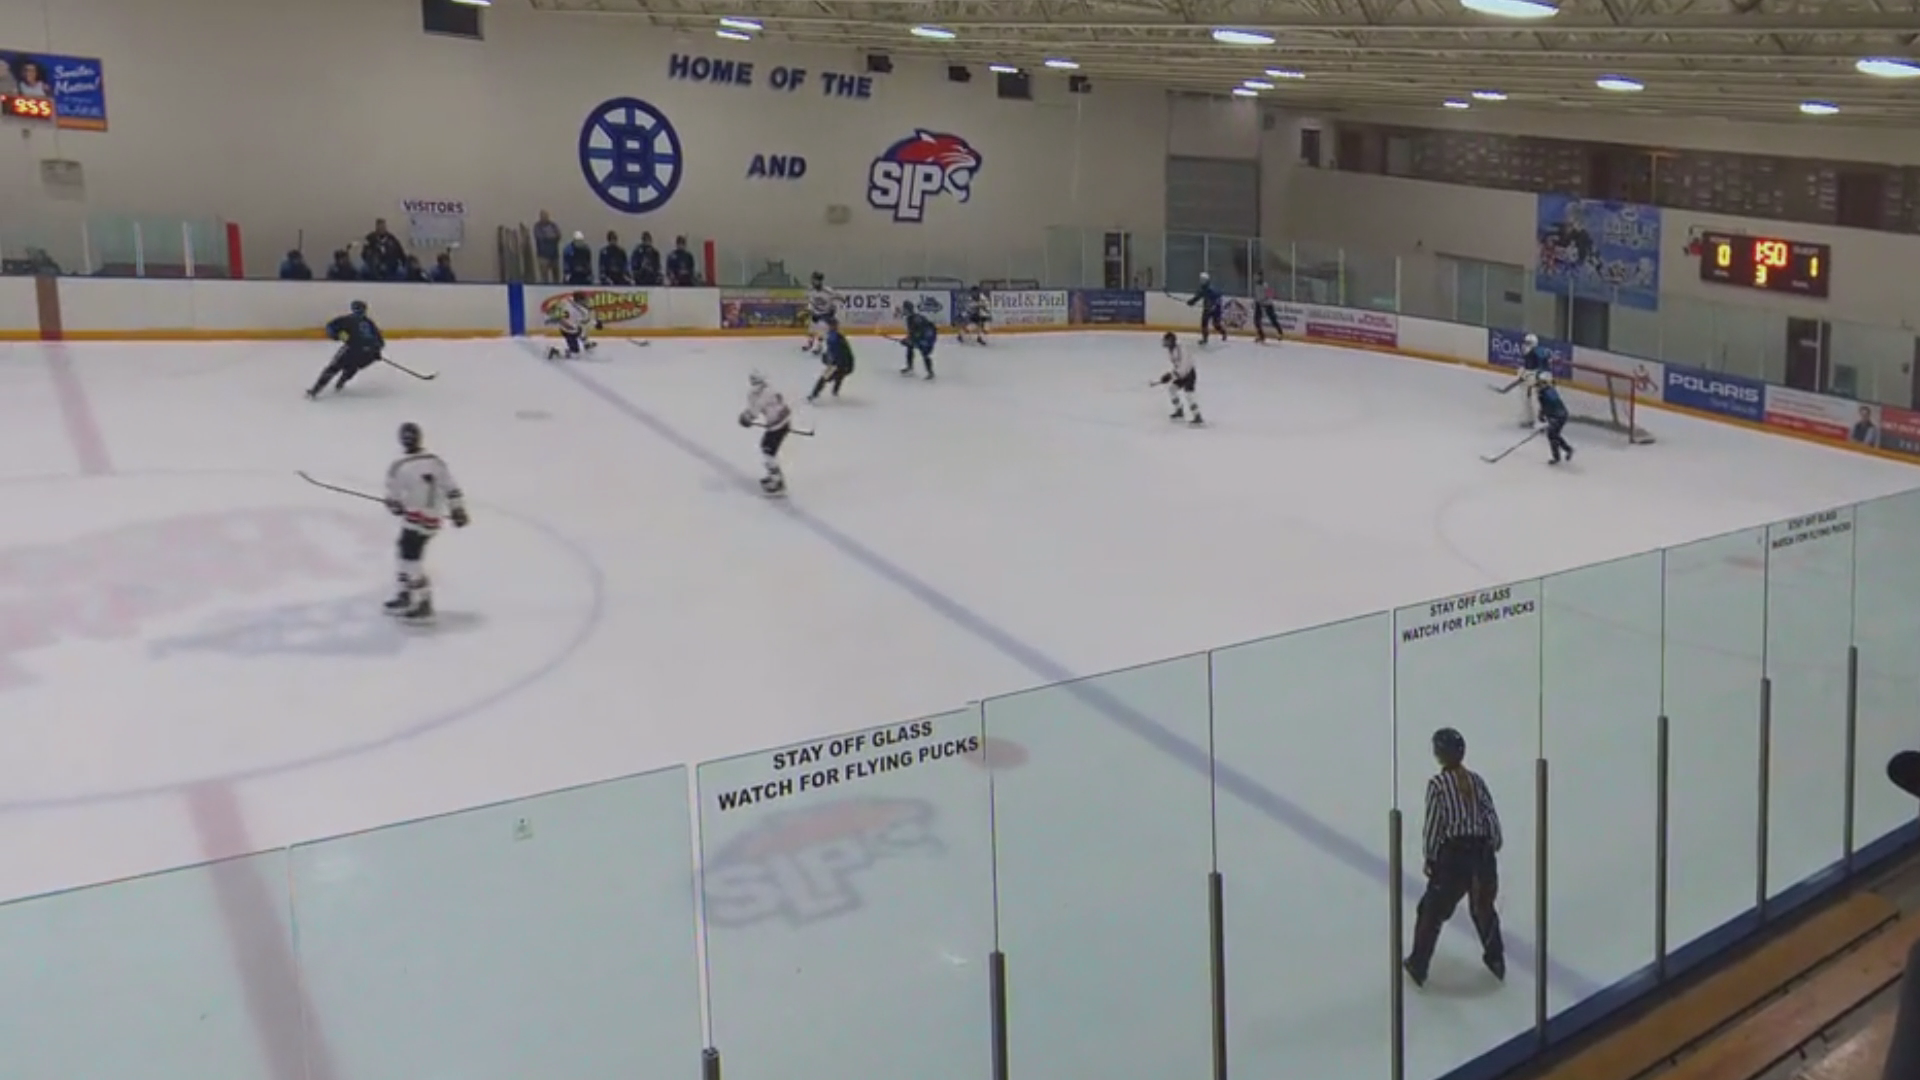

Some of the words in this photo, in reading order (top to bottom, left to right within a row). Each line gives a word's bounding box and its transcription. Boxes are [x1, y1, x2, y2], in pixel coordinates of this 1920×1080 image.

[668, 54, 753, 86] HOME
[770, 66, 806, 91] OF
[821, 72, 873, 98] THE
[747, 154, 807, 179] AND
[868, 157, 946, 222] SLP
[403, 200, 464, 214] VISITORS
[1716, 243, 1731, 267] 0
[1809, 256, 1819, 278] 1
[1755, 264, 1768, 284] 3
[1669, 373, 1759, 402] POLARIS
[1430, 602, 1456, 617] STAY
[1457, 595, 1477, 610] OFF
[1480, 587, 1511, 604] GLASS
[1402, 623, 1440, 642] WATCH
[1442, 617, 1462, 633] FOR
[1465, 608, 1500, 627] FLYING
[1503, 601, 1534, 618] PUCKS
[773, 745, 823, 770] STAY
[829, 735, 866, 757] OFF
[872, 721, 933, 747] GLASS
[717, 779, 793, 811] WATCH
[800, 768, 841, 791] FOR
[845, 751, 913, 780] FLYING
[919, 736, 979, 762] PUCKS
